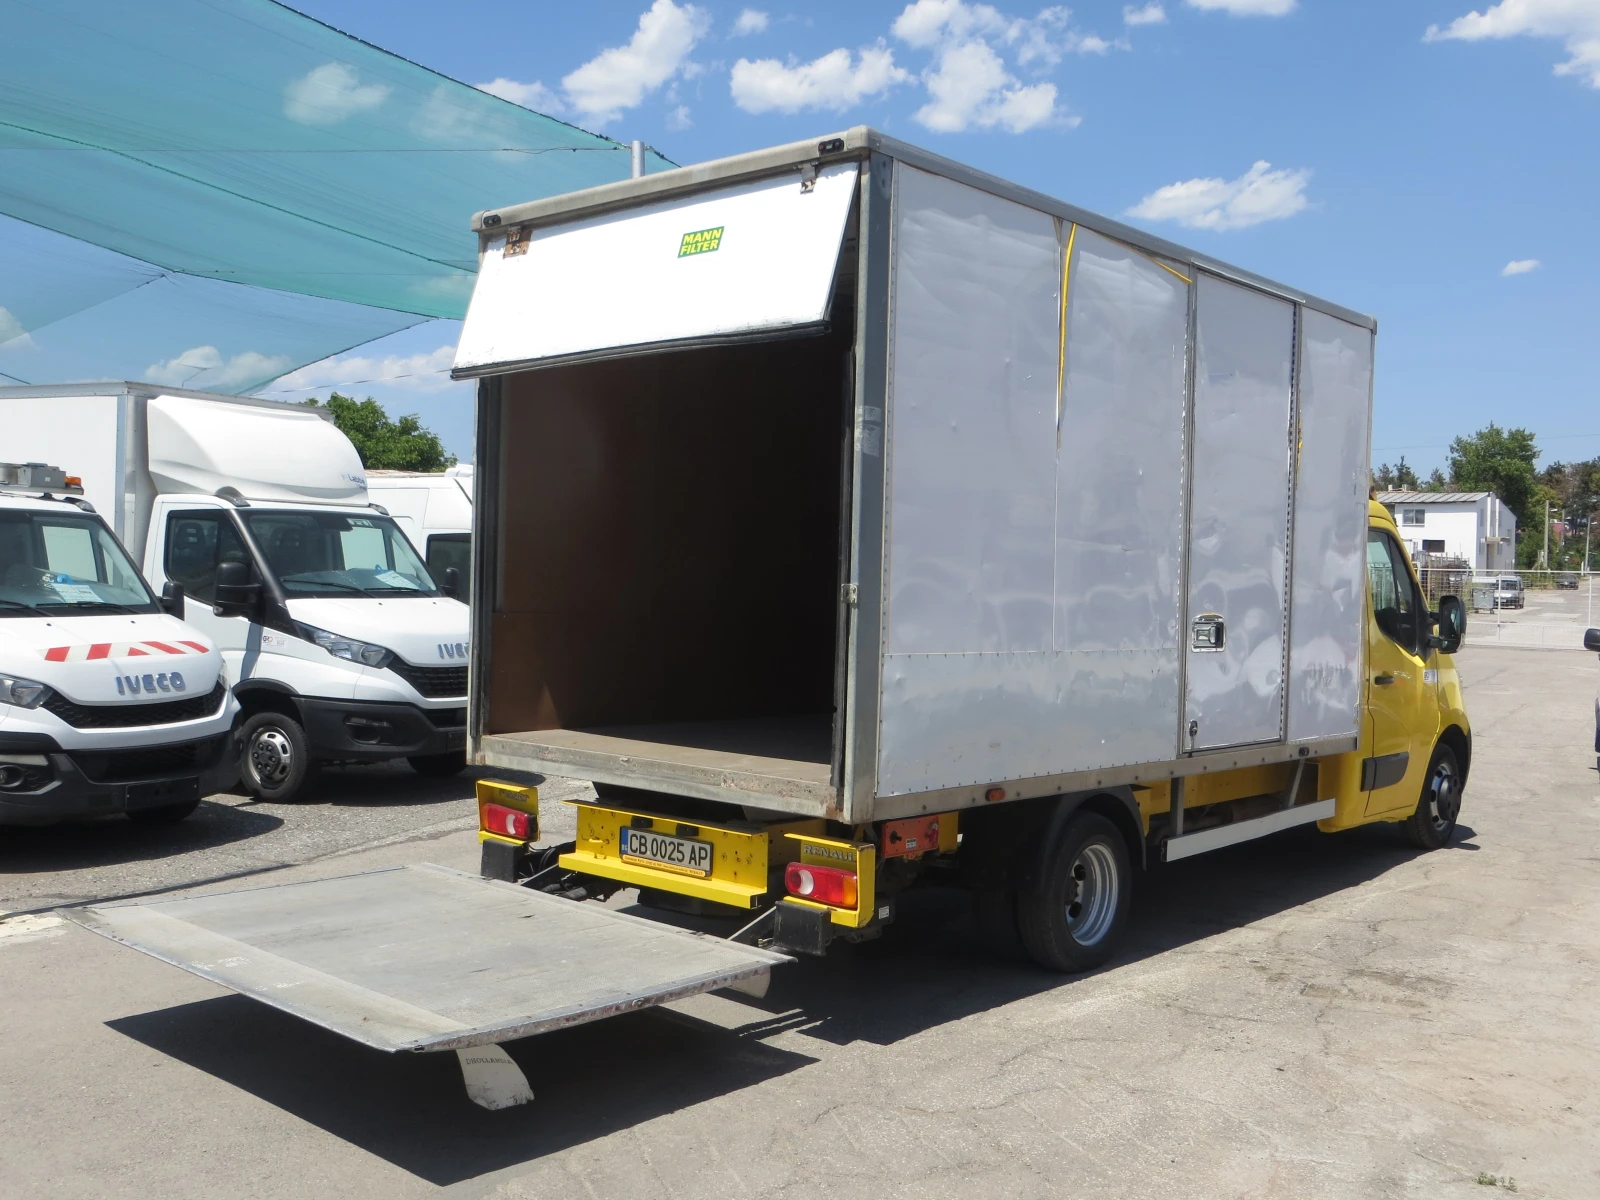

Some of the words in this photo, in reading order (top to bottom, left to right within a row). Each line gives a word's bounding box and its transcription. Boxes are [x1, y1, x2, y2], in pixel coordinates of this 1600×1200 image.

[683, 228, 723, 246] MANN
[680, 239, 719, 256] FILTER
[437, 642, 470, 660] IVEC
[115, 671, 186, 696] IVECO
[629, 833, 648, 856] CB
[650, 837, 685, 863] 0025
[688, 844, 708, 867] AP
[803, 844, 857, 863] RENAUL
